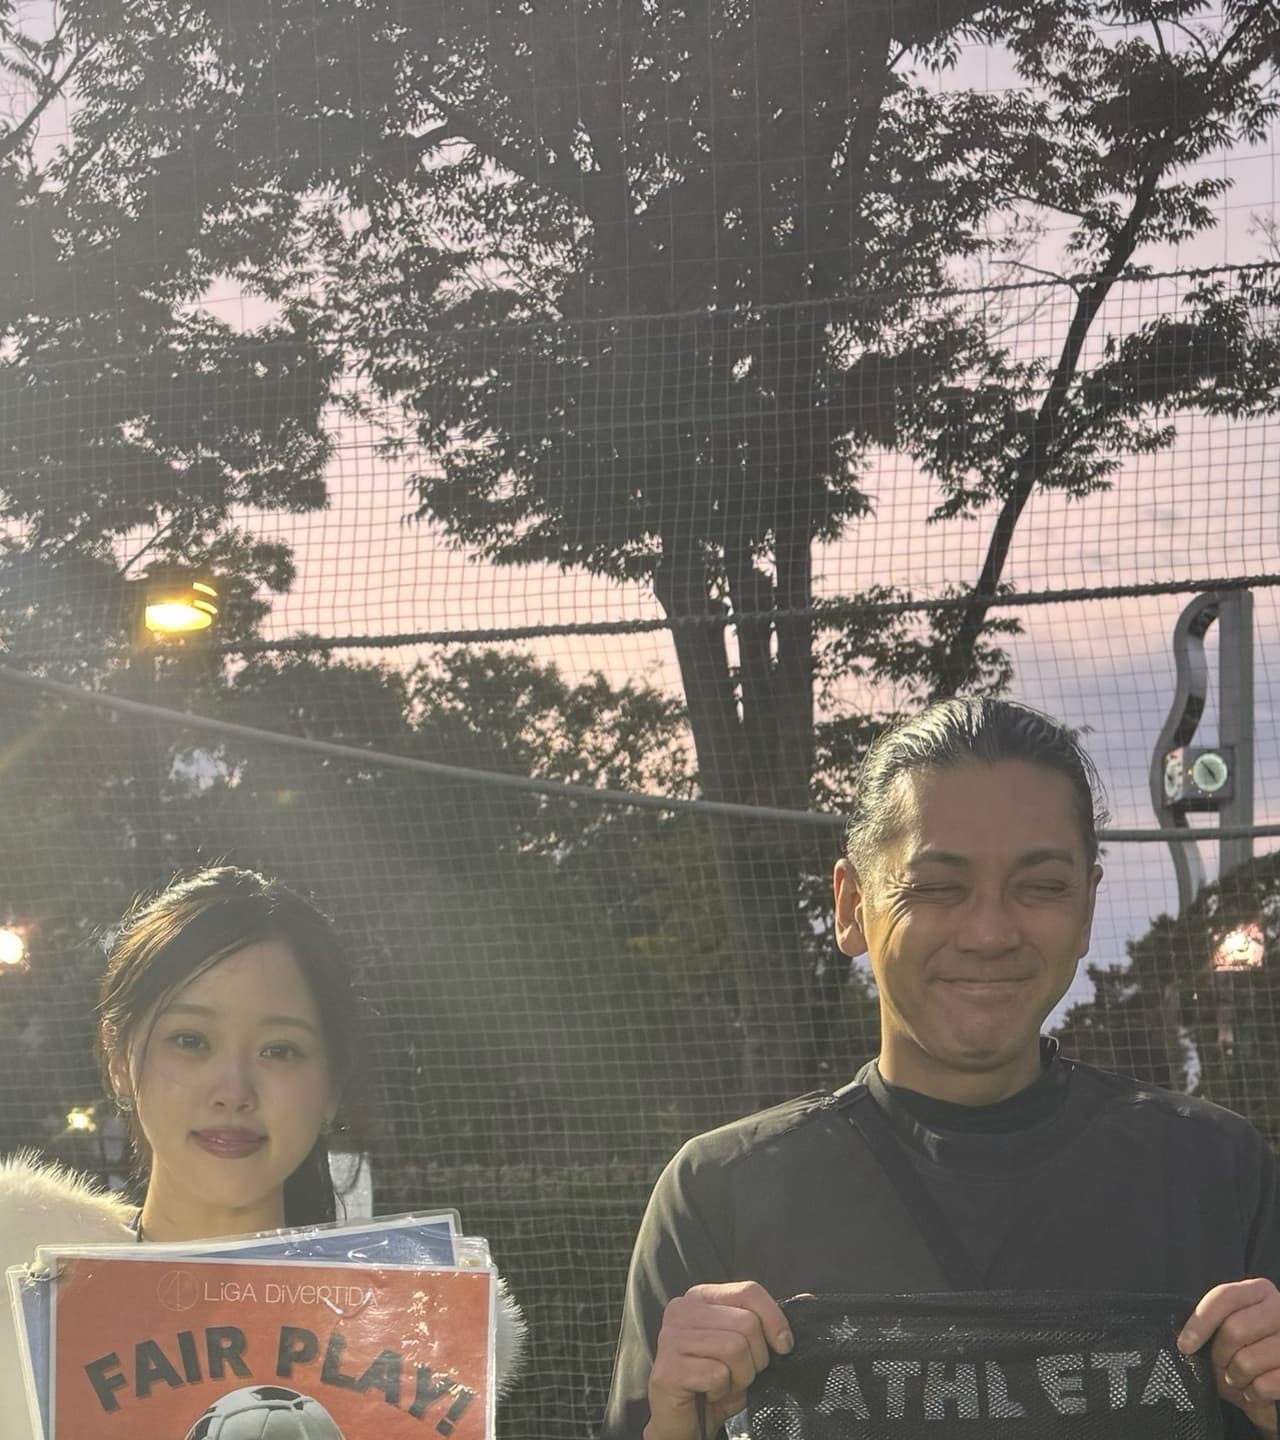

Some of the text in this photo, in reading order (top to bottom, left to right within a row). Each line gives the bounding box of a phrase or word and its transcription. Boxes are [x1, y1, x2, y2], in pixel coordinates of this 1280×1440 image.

[84, 1326, 473, 1437] FAIR PLAY!
[815, 1348, 1195, 1420] ATHLETA
